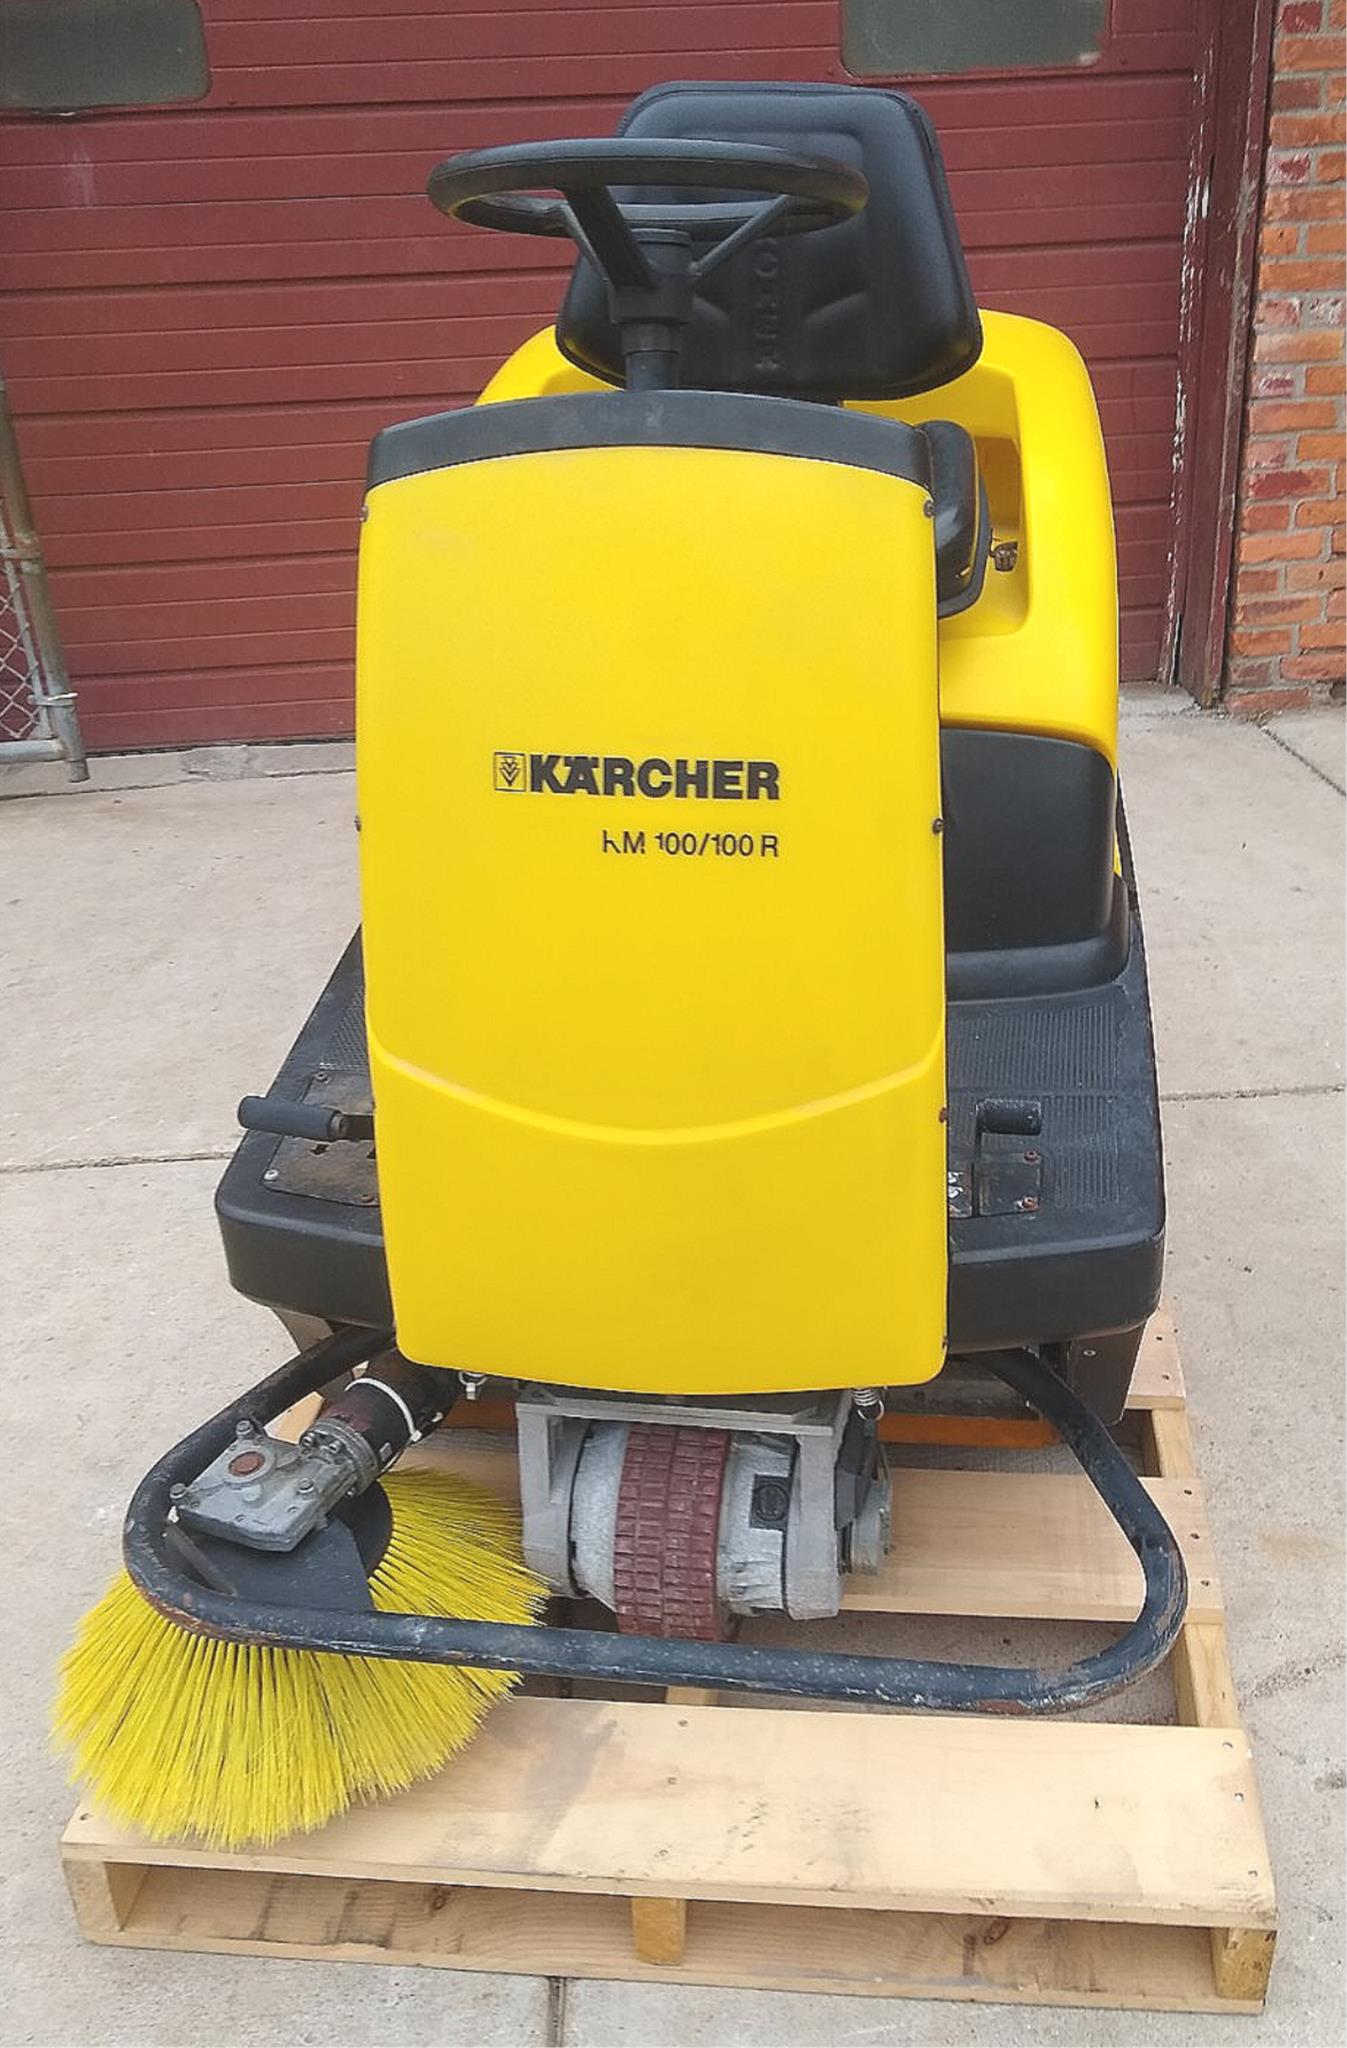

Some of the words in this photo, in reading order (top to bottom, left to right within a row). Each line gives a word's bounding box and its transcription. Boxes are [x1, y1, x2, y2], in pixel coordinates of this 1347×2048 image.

[530, 754, 780, 800] KÄRCHER
[655, 832, 754, 857] 100/100
[761, 835, 779, 857] R
